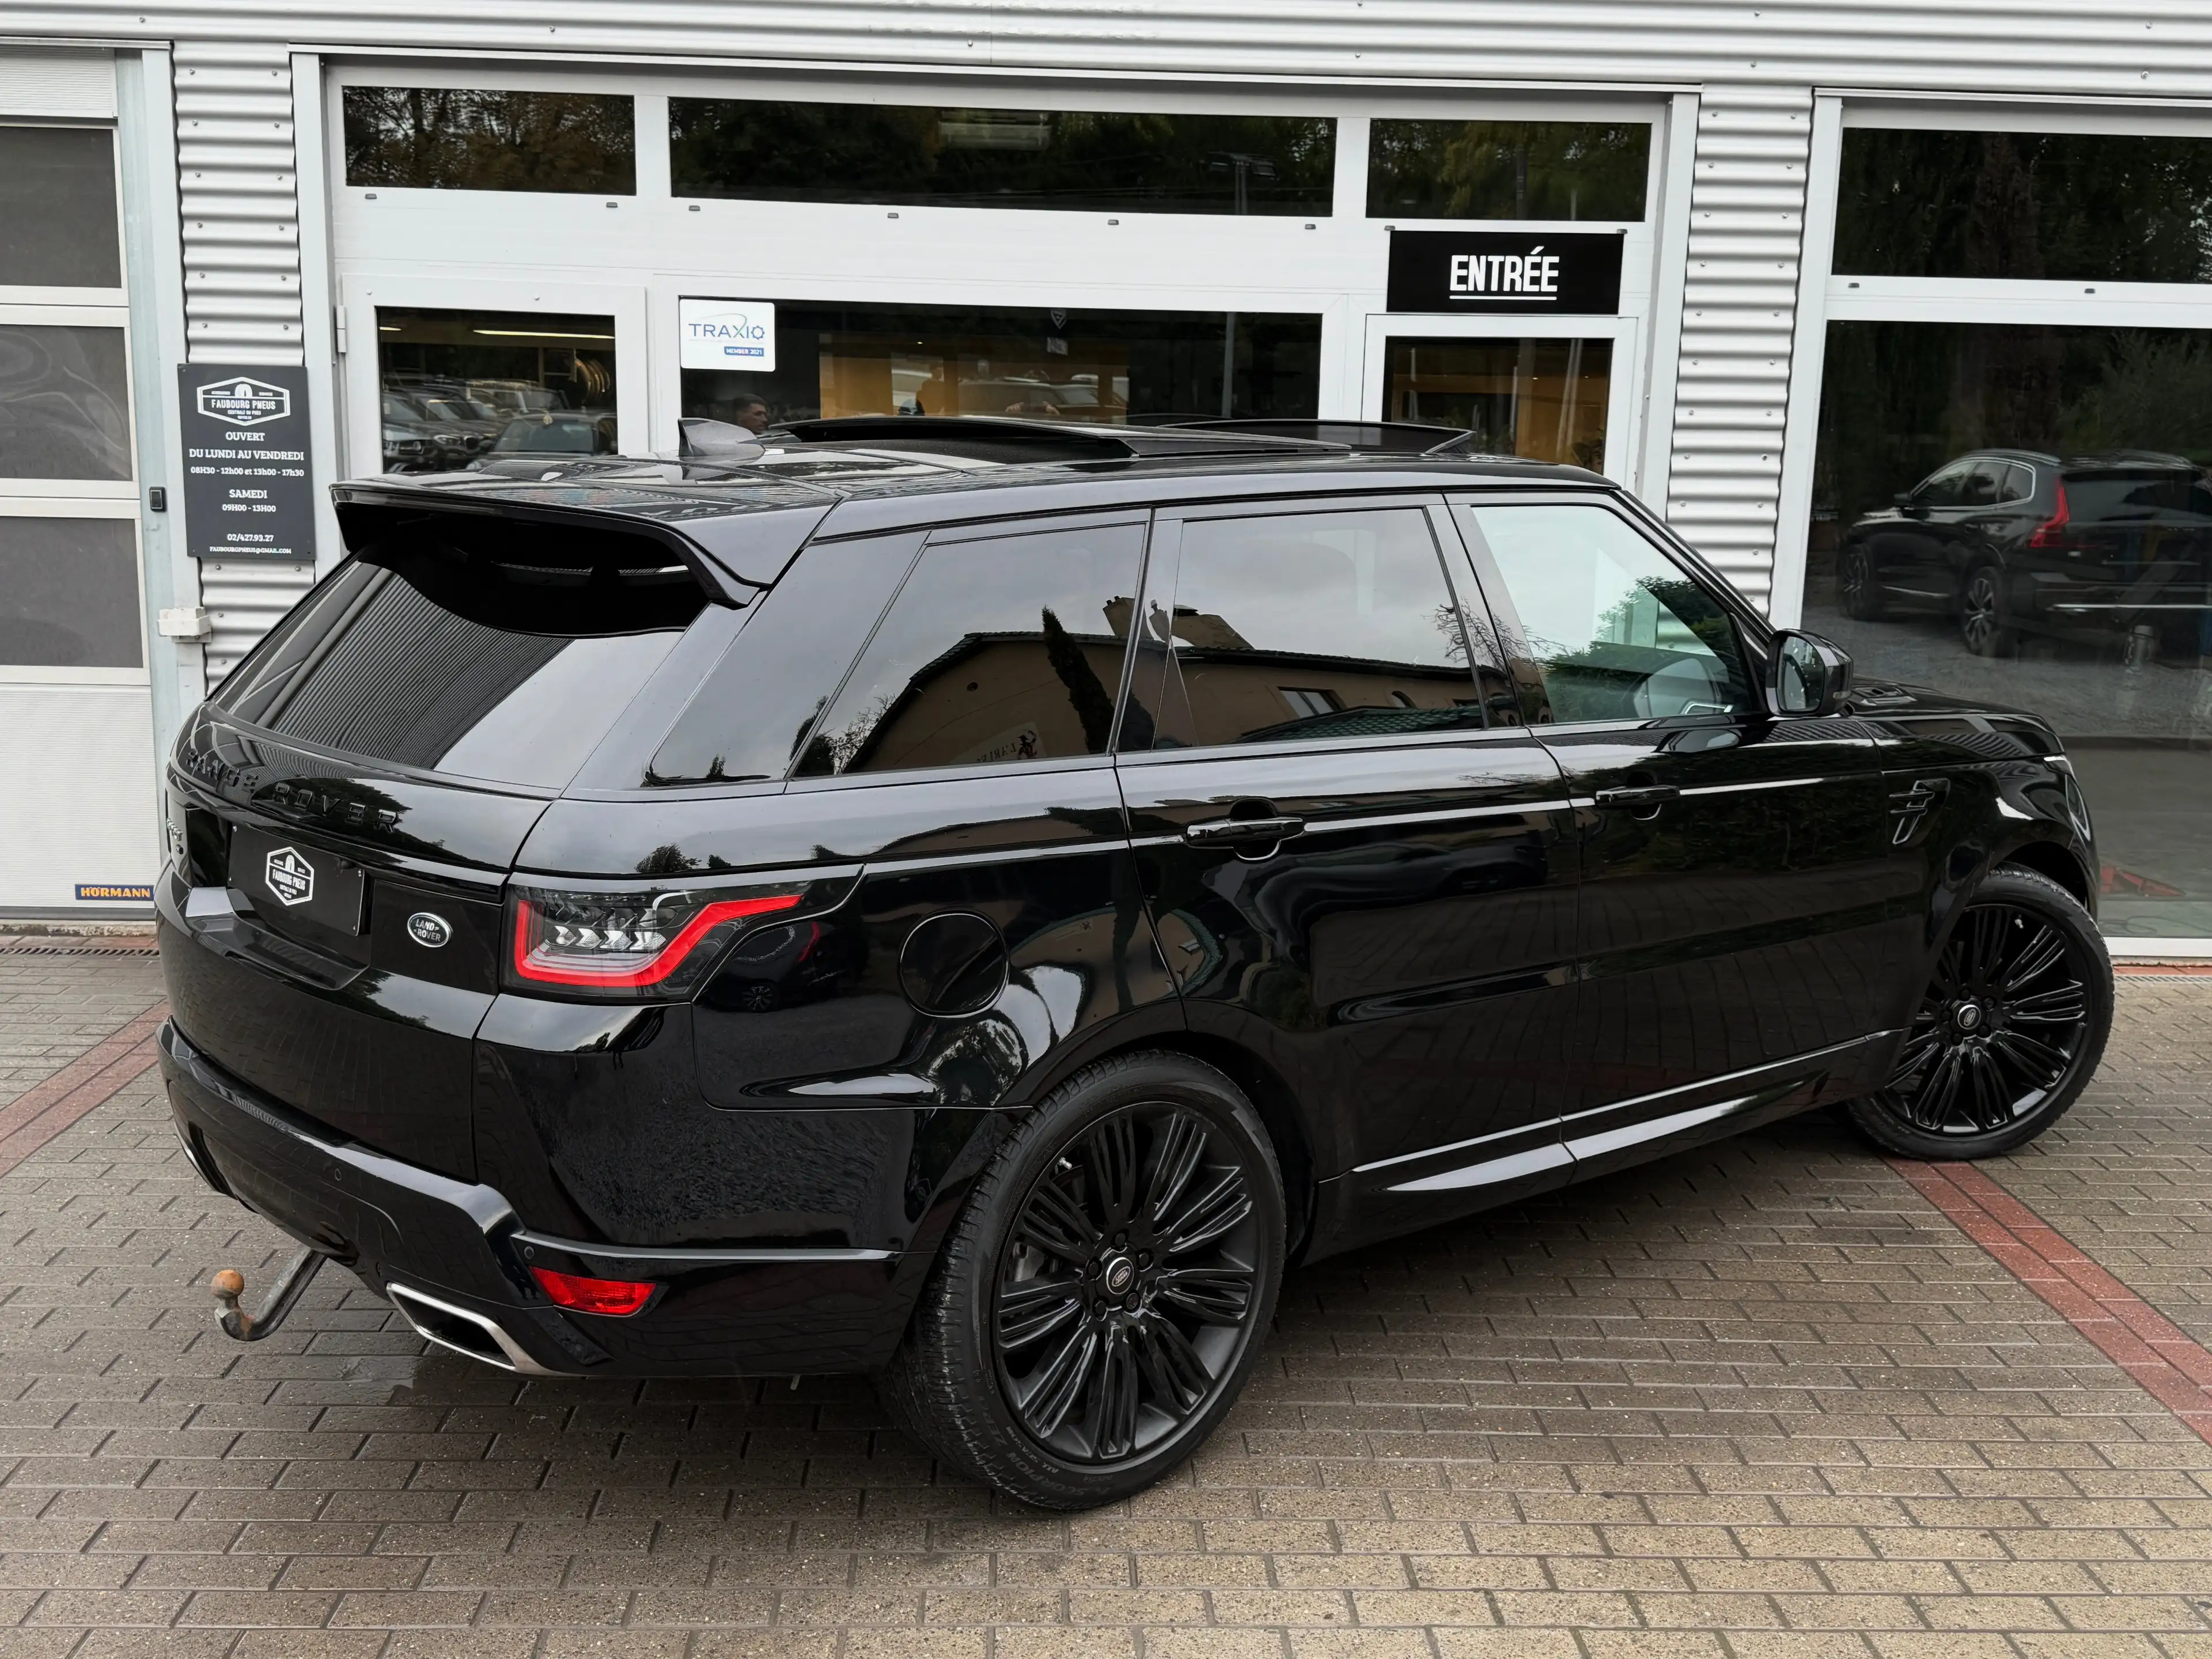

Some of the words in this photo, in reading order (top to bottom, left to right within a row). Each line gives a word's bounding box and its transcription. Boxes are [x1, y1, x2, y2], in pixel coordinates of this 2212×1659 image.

[1450, 246, 1559, 291] ENTRÉE
[688, 323, 765, 340] TRAXIO
[211, 399, 250, 409] FAUBOURG
[252, 400, 275, 410] PNEUS
[226, 431, 265, 441] OUVERT
[189, 449, 203, 457] DU
[205, 449, 236, 459] LUNDI
[237, 450, 252, 459] AU
[253, 450, 304, 460] VENDREDI
[282, 468, 305, 476] 17h30
[229, 489, 268, 499] SAMEDI
[227, 533, 274, 542] 02/427.93.27
[209, 546, 291, 554] FAUBOURGPNEUS@GMAIL.COM
[274, 781, 399, 833] ROVER
[81, 887, 150, 897] HÖRMANN
[416, 919, 435, 931] LAND
[417, 928, 441, 941] ROVER
[1006, 1426, 1039, 1464] SEASON
[1041, 1461, 1059, 1474] ALL
[1007, 1452, 1085, 1496] SCORPION
